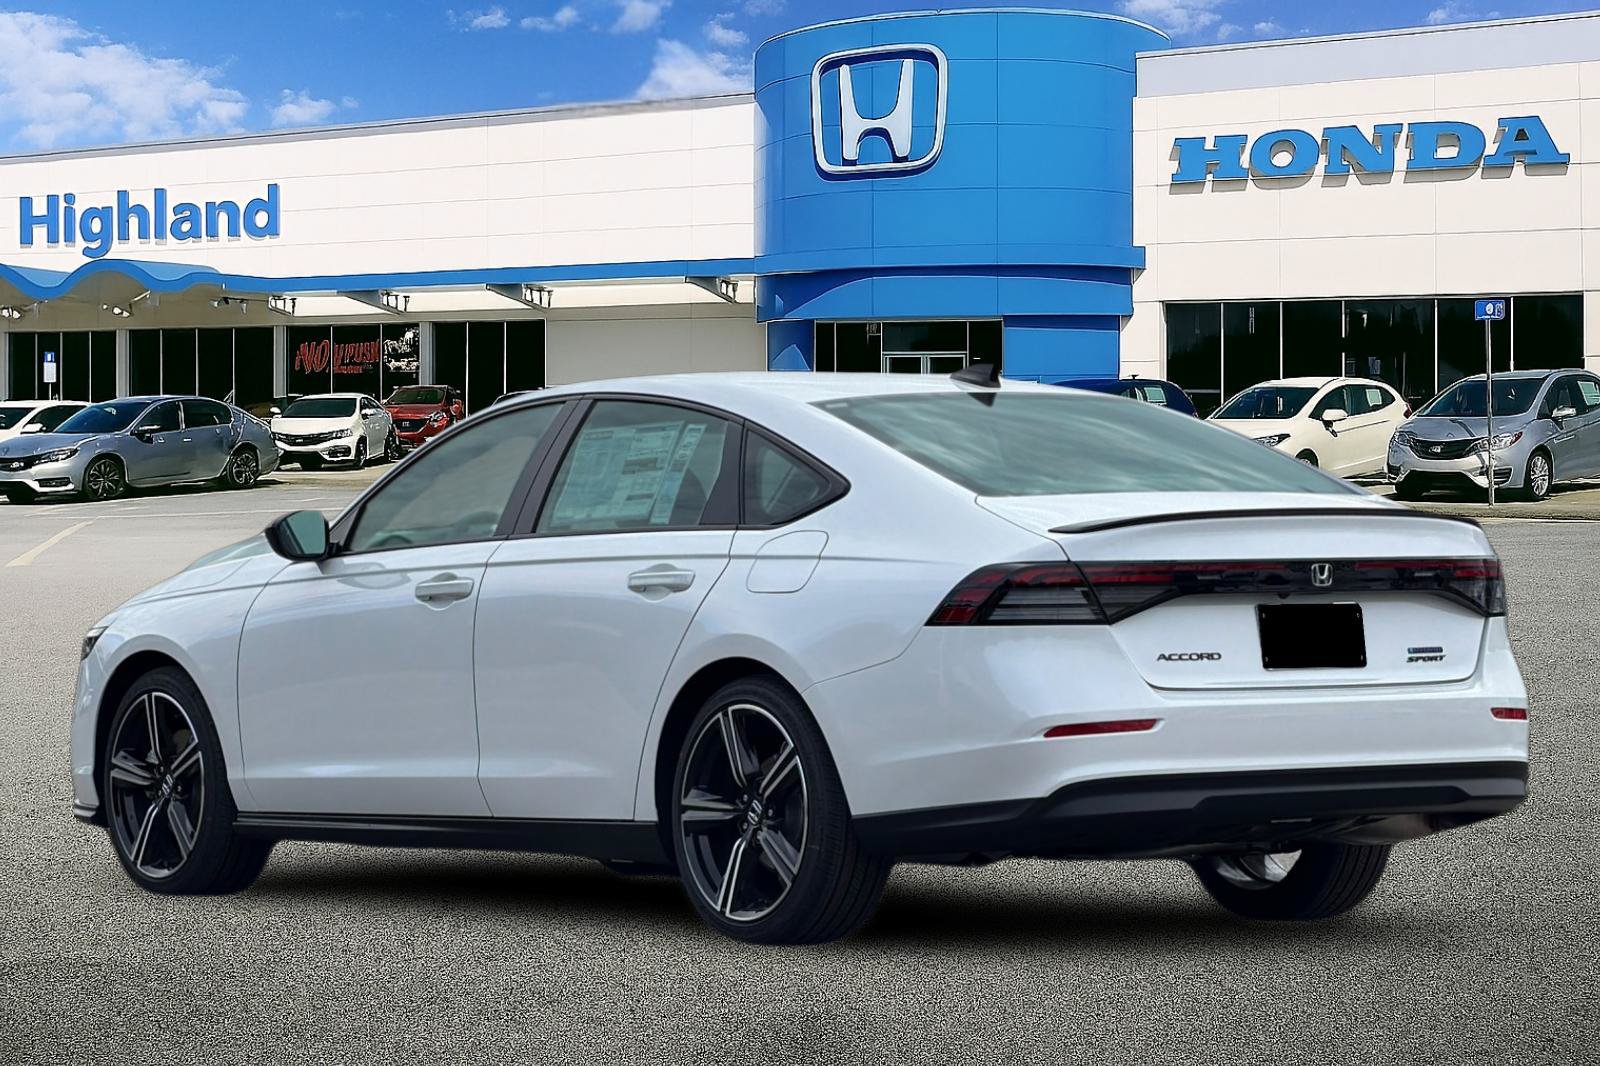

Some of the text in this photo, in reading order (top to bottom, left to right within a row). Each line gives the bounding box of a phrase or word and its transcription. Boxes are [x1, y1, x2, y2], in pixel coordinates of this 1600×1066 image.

[1171, 116, 1570, 184] HONDA
[19, 183, 280, 257] Highland
[1157, 652, 1222, 661] ACCORD
[1407, 655, 1446, 663] SPORT
